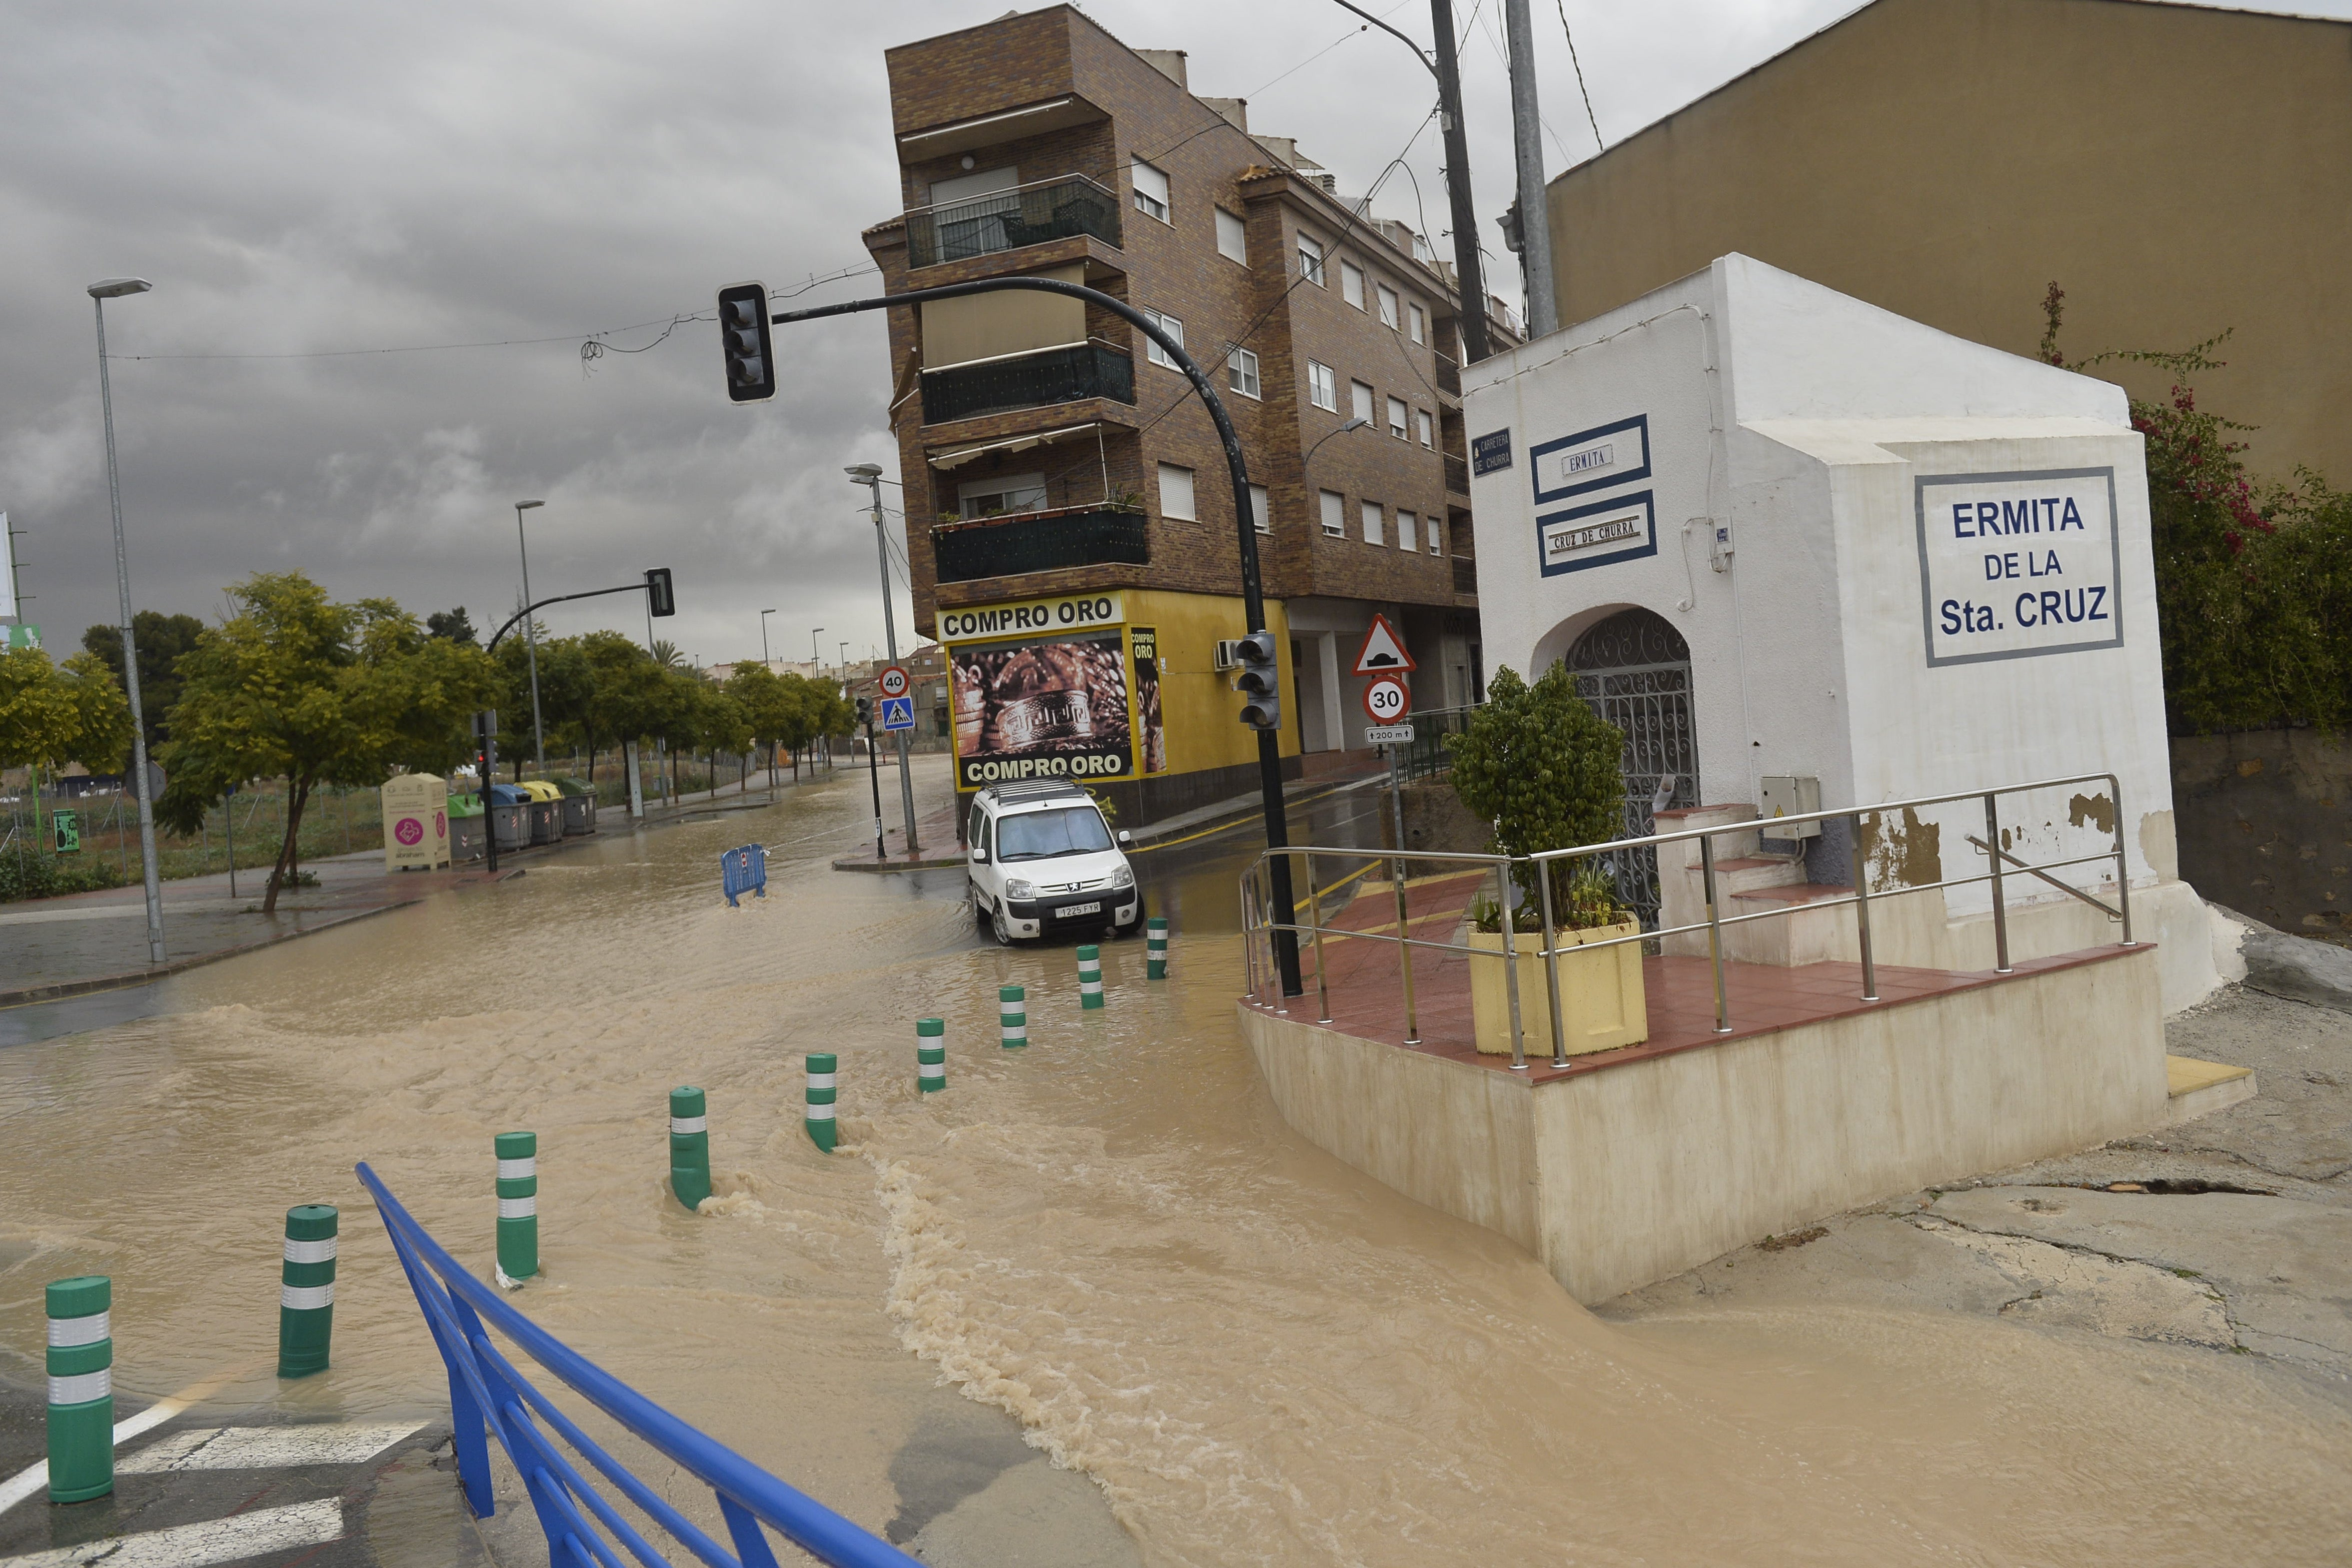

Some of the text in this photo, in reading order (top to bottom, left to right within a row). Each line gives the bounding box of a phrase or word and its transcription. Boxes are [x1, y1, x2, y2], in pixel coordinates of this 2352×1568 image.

[1481, 433, 1509, 452] CARRETERA
[1475, 452, 1510, 472] DE CHURRA
[1570, 453, 1605, 471] ERMITA
[1953, 497, 2085, 538] ERMITA
[1555, 521, 1634, 548] CRUZ DE CHURRA
[1984, 549, 2063, 581] DE LA
[943, 597, 1112, 636] COMPRO ORO
[1941, 586, 2108, 635] Sta. CRUZ
[1131, 633, 1154, 643] COMPRO
[1135, 645, 1153, 659] ORO
[886, 676, 902, 687] 40
[1373, 690, 1400, 708] 30
[967, 754, 1121, 781] COMPRO ORO
[1063, 904, 1098, 916] 1225 FYR
